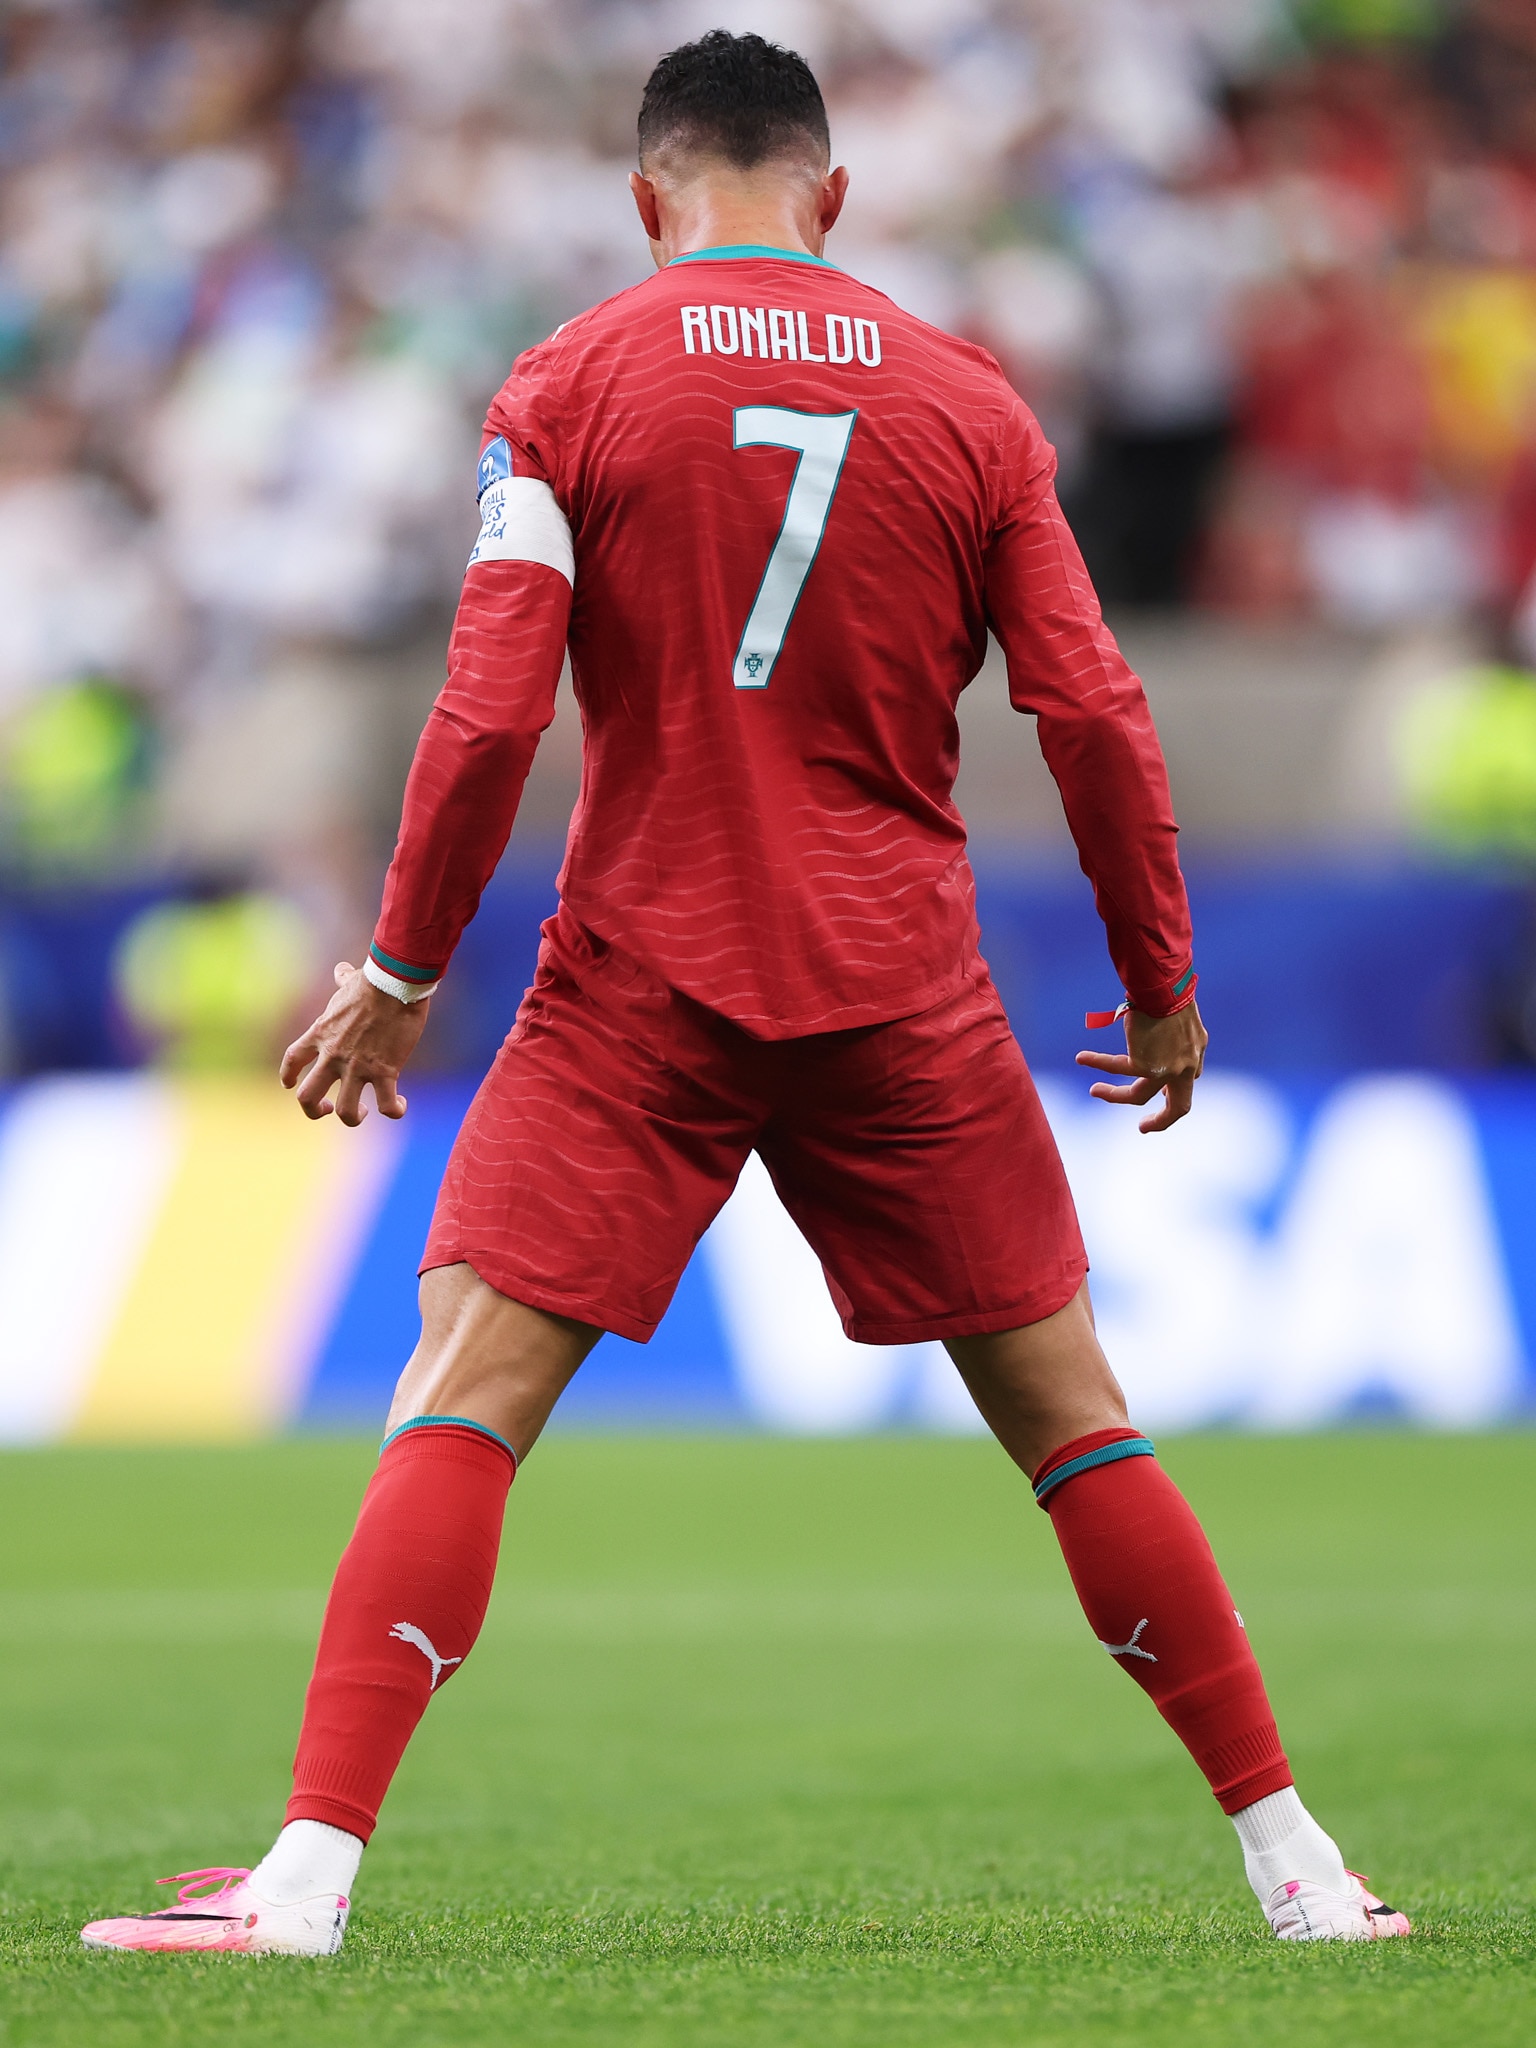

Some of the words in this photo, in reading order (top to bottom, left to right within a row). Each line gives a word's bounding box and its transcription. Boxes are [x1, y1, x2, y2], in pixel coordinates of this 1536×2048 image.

[680, 305, 882, 367] RONALDO
[732, 405, 860, 689] 7
[700, 1072, 1522, 1428] VSA
